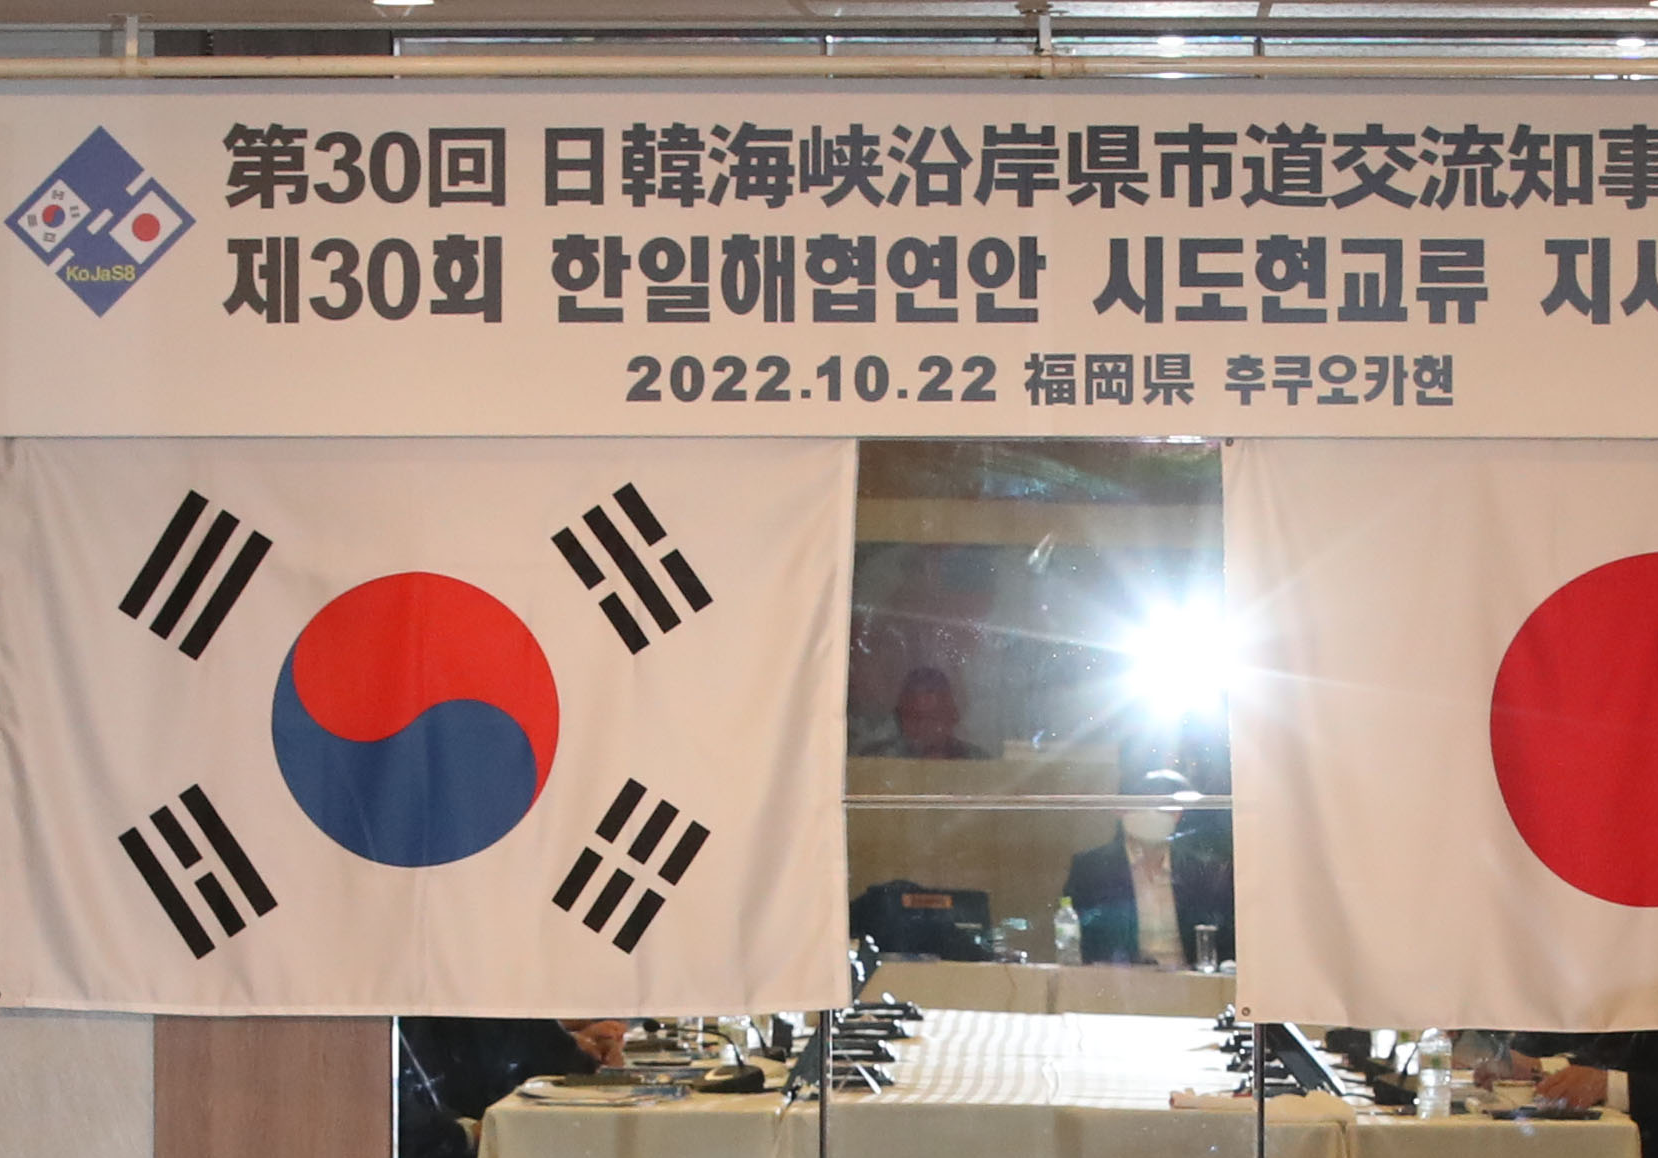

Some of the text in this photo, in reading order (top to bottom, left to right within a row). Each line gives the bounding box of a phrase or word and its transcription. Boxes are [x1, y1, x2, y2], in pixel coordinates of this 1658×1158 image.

[223, 122, 506, 209] 第30回
[65, 264, 136, 282] KoJaS8
[223, 234, 503, 323] 제30회
[551, 234, 1047, 324] 한일해협연안
[1092, 234, 1489, 324] 시도현교류
[626, 353, 1454, 406] 2022.10.22 福岡県 후쿠오카현
